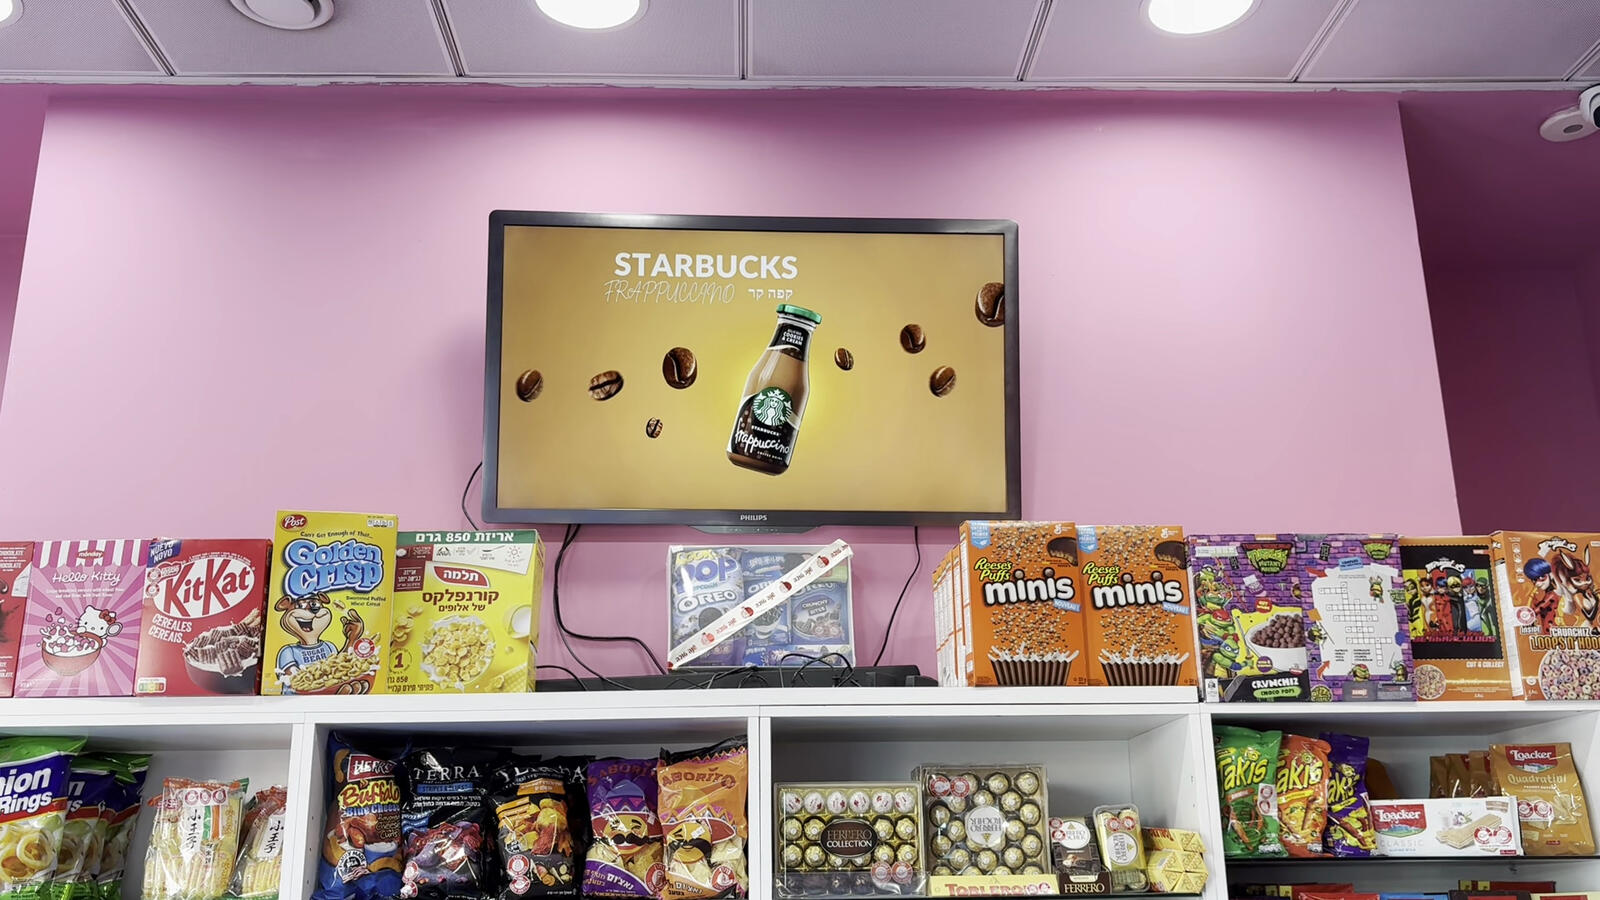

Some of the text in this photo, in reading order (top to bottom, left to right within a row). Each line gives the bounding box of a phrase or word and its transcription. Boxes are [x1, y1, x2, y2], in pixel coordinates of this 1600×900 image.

[614, 252, 798, 279] STARBUCKS
[604, 280, 736, 304] FRAPPUCCINO
[748, 288, 793, 300] קפה קר
[784, 331, 804, 342] COOKIES
[786, 337, 802, 346] CREAM
[751, 425, 780, 436] STARBUCKS
[284, 514, 304, 528] Post
[416, 532, 514, 542] אריזת 850 גרם
[150, 542, 174, 557] NUEVO
[286, 538, 382, 566] Golden
[154, 549, 173, 563] NOVO
[974, 558, 1012, 570] Reese's
[1083, 562, 1120, 574] Reese's
[52, 572, 121, 586] Hello Kitty
[286, 560, 382, 598] Crisp
[443, 570, 478, 581] תלמה
[980, 570, 1010, 582] Puffs
[1088, 573, 1118, 585] Puffs
[164, 559, 250, 617] KitKat
[984, 568, 1074, 605] minis
[1093, 574, 1183, 608] minis
[422, 589, 500, 605] קורנפלקס
[678, 590, 736, 612] OREO
[438, 603, 469, 612] אלופים
[802, 600, 828, 608] CRUNCHY
[810, 607, 825, 615] BITES
[152, 614, 193, 632] CEREALES
[148, 626, 183, 644] CEREAIS
[1551, 627, 1591, 636] CRUNCHIZ
[1532, 636, 1566, 650] LOOPS
[303, 654, 327, 663] BEAR
[394, 653, 404, 668] 1
[1252, 678, 1299, 689] CRUNCHIZ
[1510, 750, 1552, 760] Loacker
[414, 765, 480, 780] TERRA
[1218, 757, 1268, 797] Takis
[1507, 774, 1567, 784] Quadratini
[341, 780, 400, 807] Buffalo
[0, 792, 52, 815] Rings
[344, 806, 370, 817] Blue
[1375, 810, 1420, 823] Loacker
[380, 830, 398, 839] Curls
[827, 829, 872, 840] FERRERO
[826, 840, 872, 848] COLLECTION
[1064, 883, 1105, 893] FERRERO
